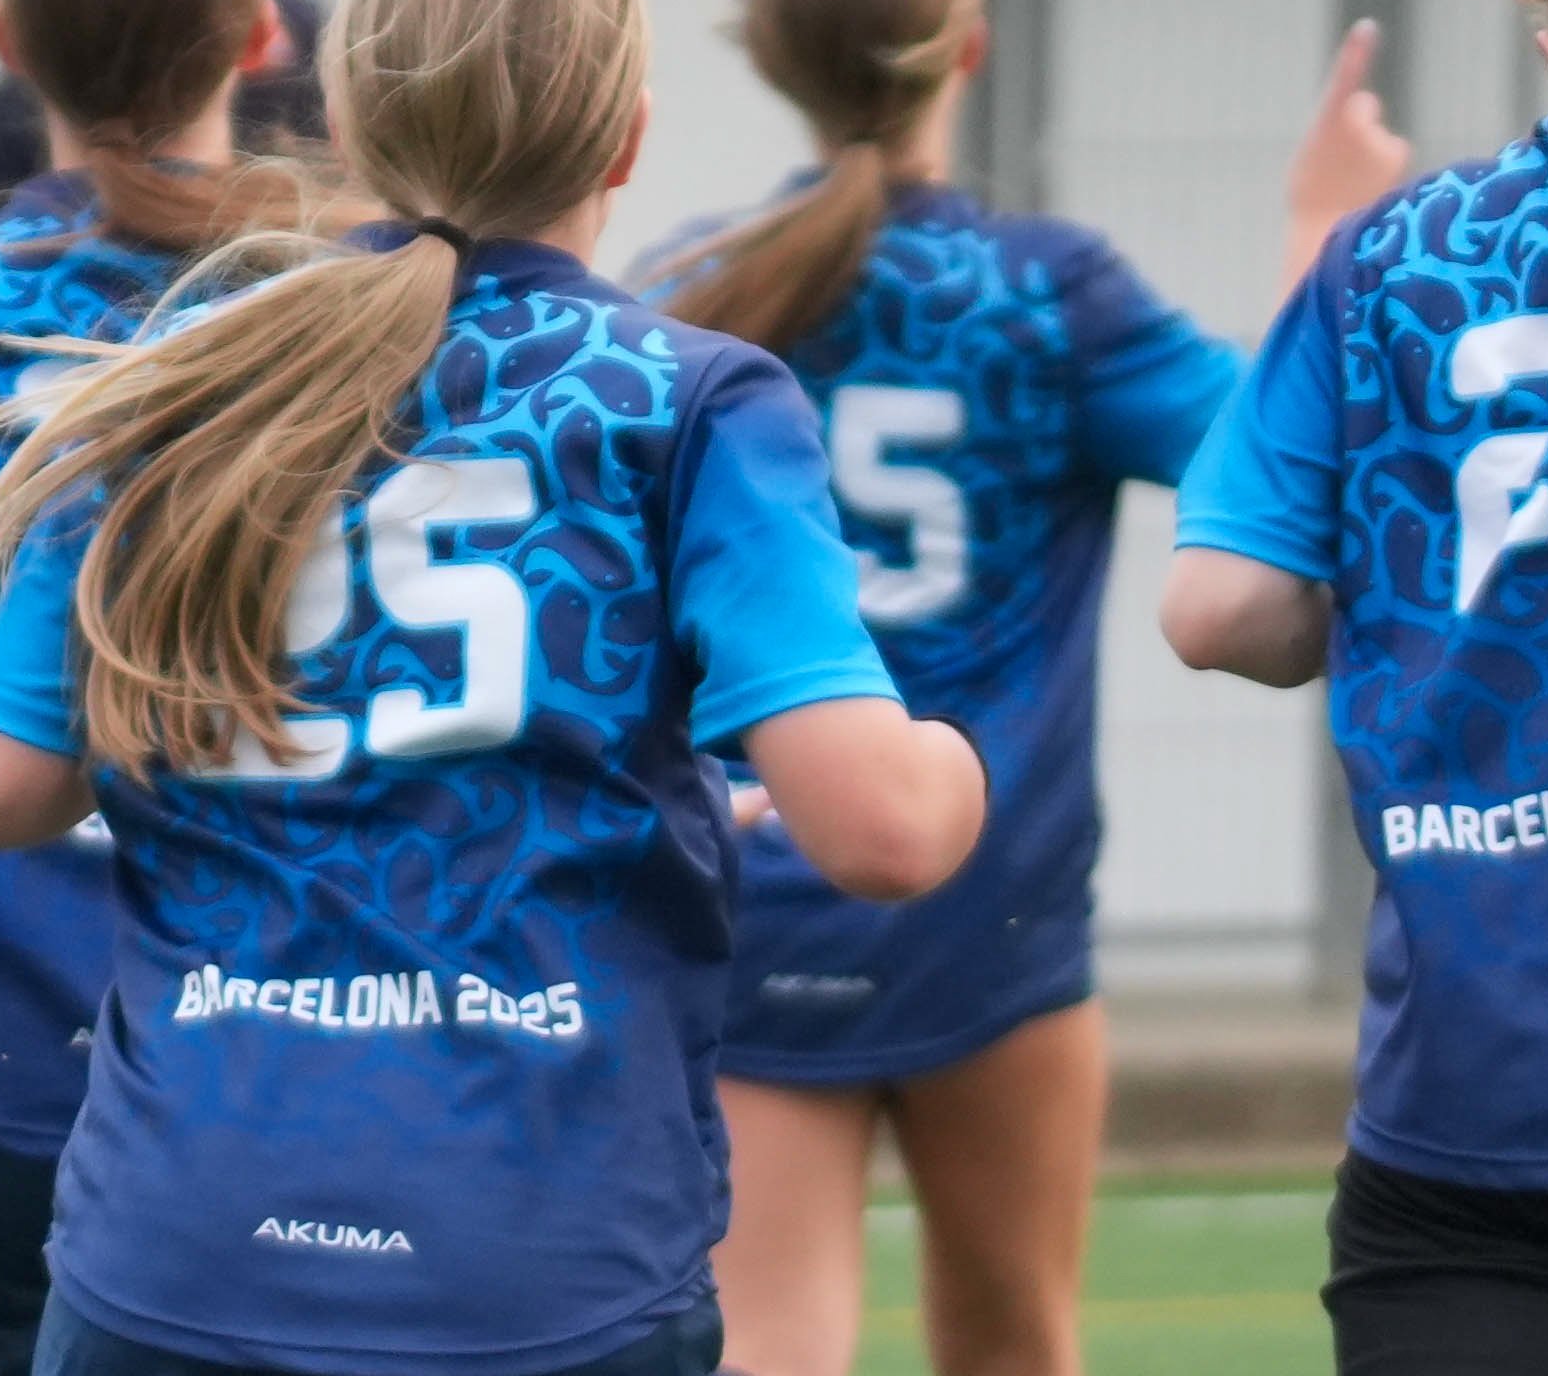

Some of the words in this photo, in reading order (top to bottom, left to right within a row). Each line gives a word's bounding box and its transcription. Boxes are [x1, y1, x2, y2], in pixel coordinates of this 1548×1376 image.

[174, 964, 442, 1026] BARCELONA
[456, 972, 584, 1036] 2025
[251, 1217, 414, 1253] AKUMA
